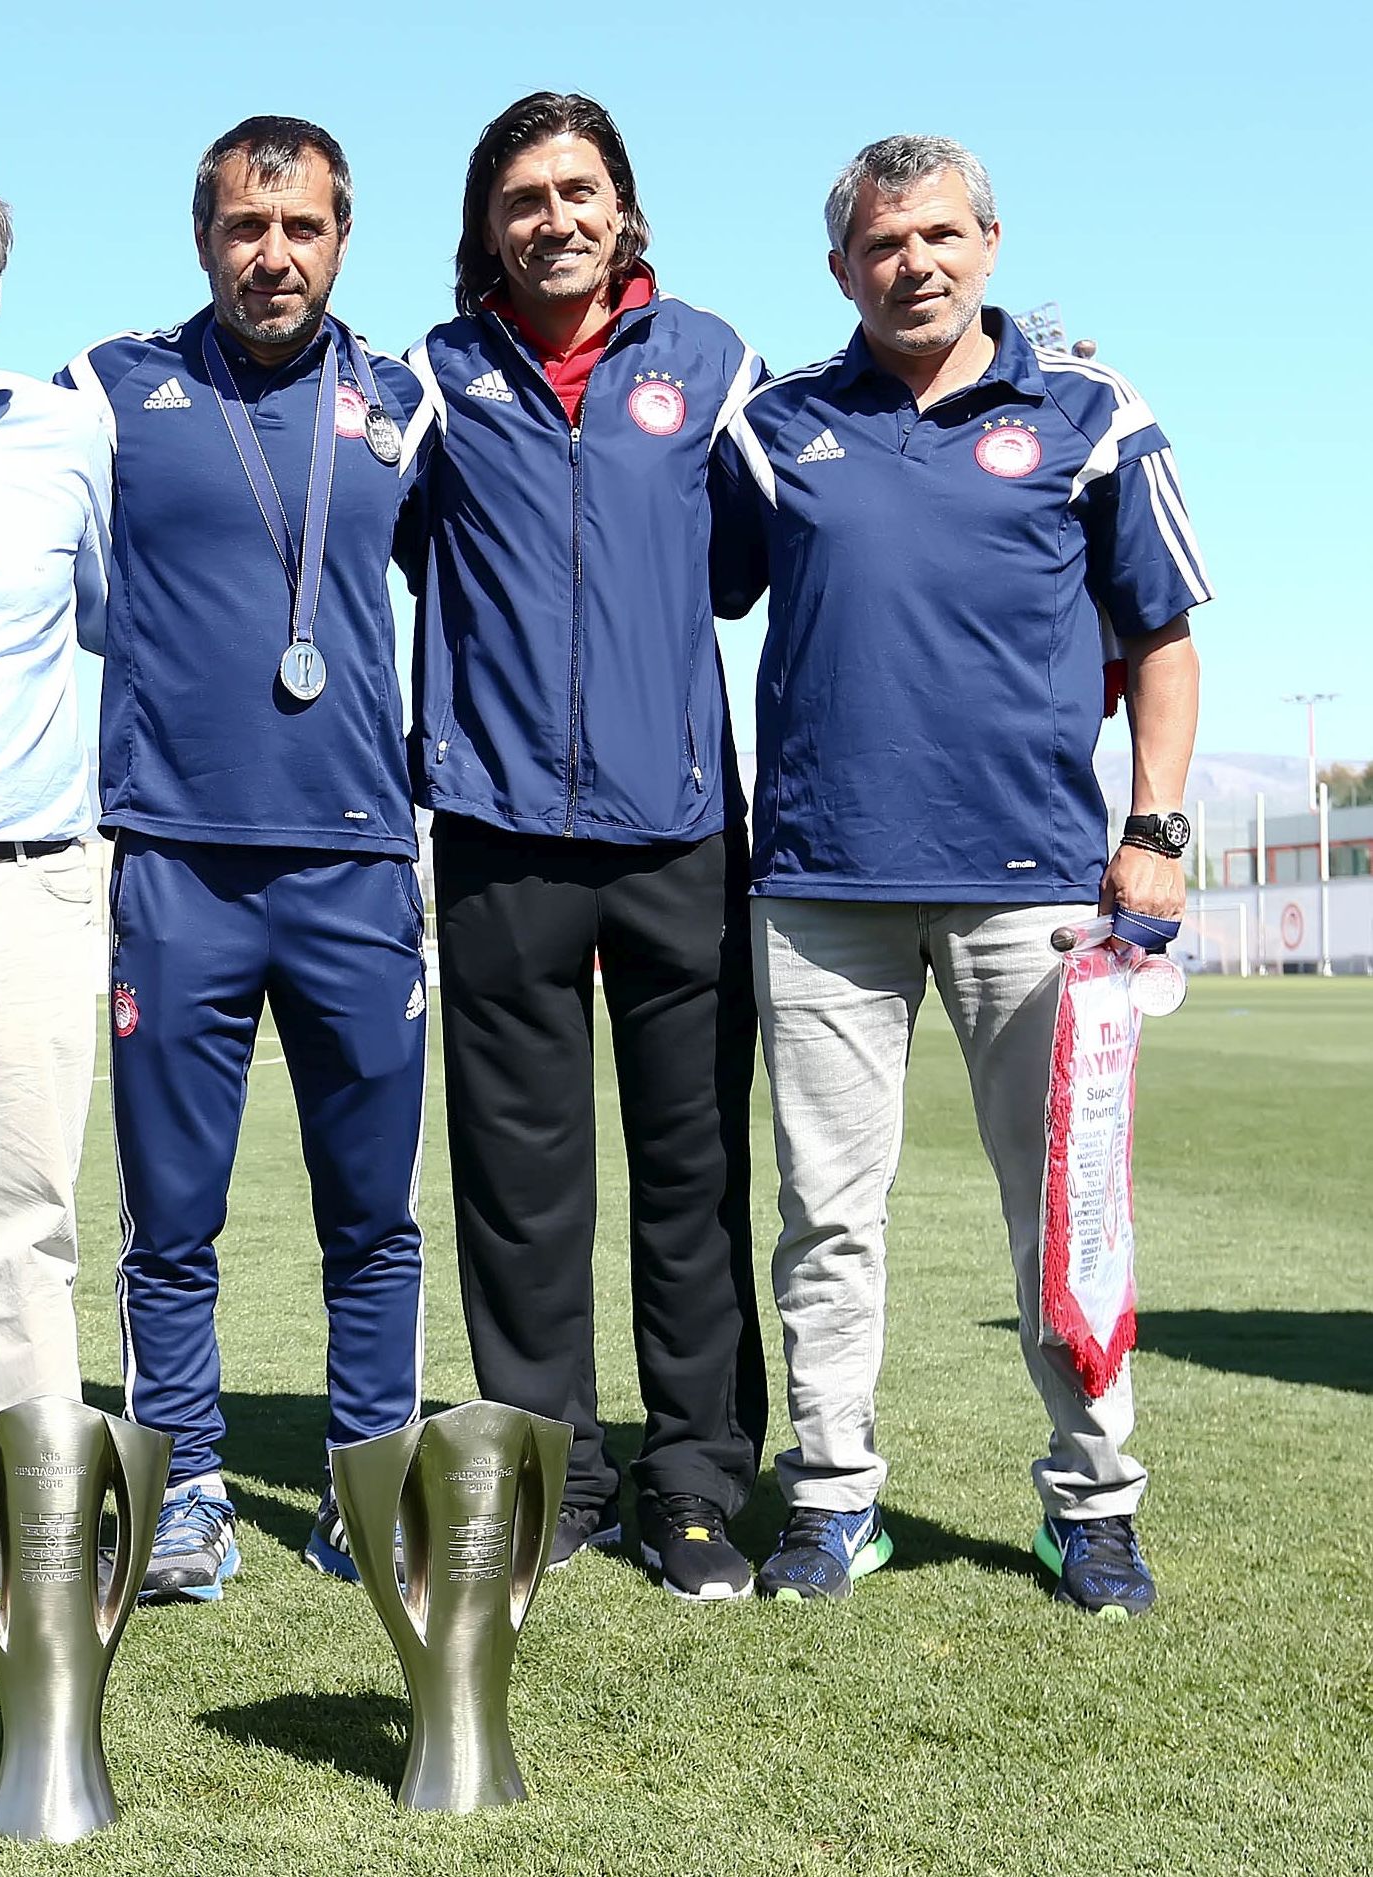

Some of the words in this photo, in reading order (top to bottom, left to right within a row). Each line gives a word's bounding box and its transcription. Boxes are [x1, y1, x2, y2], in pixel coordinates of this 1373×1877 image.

[465, 385, 513, 403] adidas
[143, 397, 191, 410] adidas
[796, 447, 846, 464] adidas
